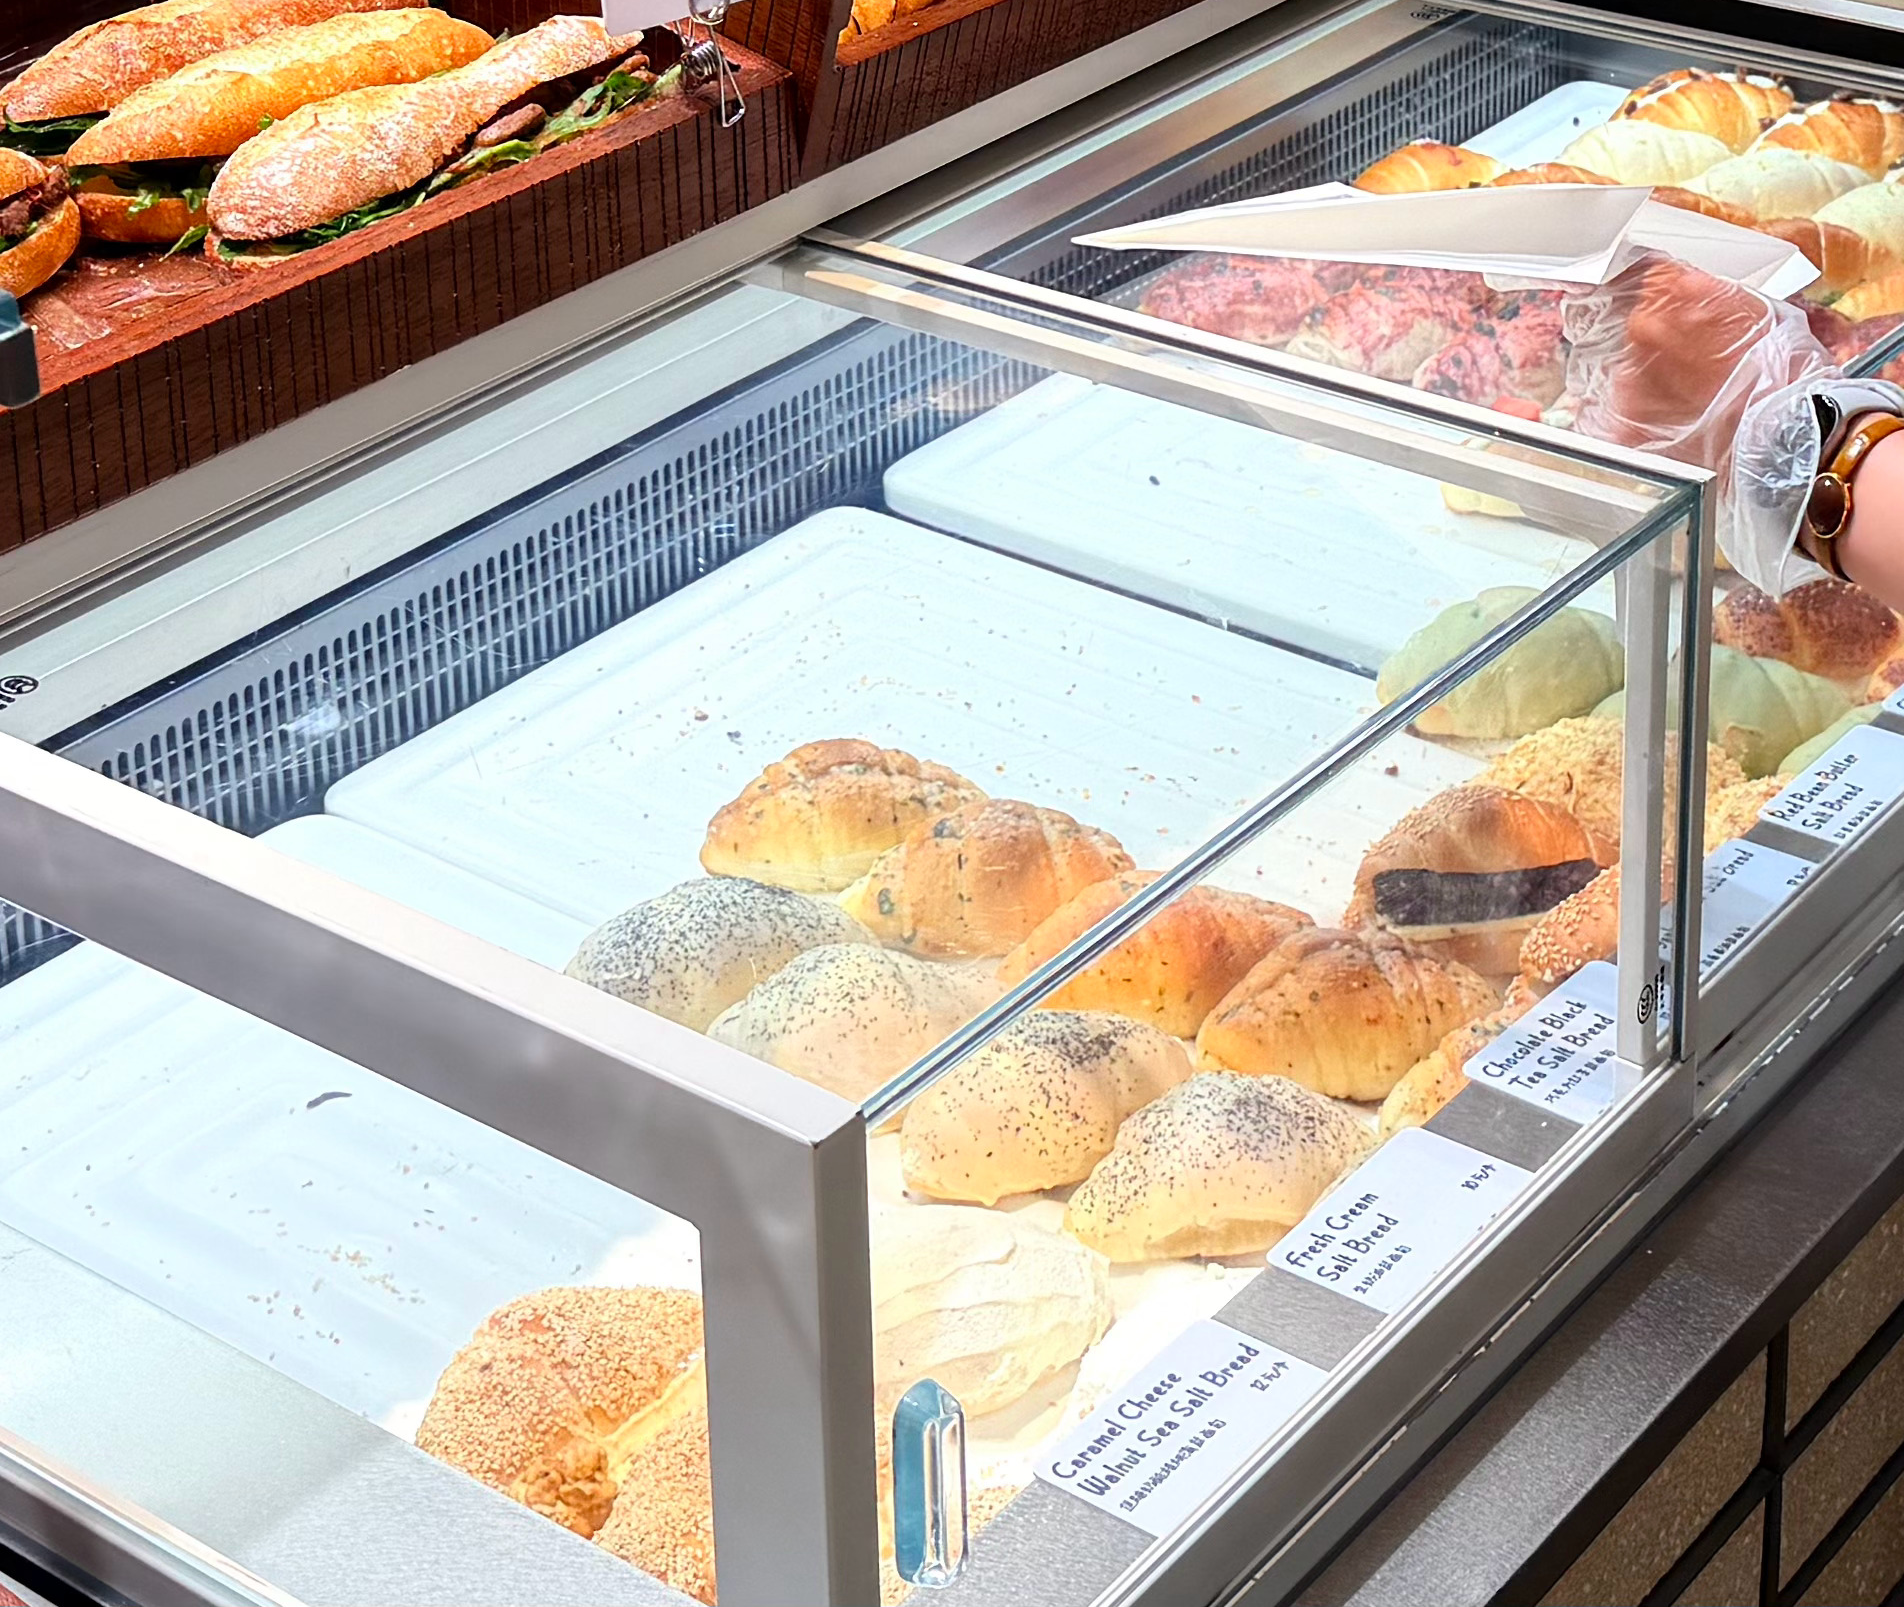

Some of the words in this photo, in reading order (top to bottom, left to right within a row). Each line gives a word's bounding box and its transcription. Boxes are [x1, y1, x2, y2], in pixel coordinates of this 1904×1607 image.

[1768, 799, 1805, 822] Red
[1789, 781, 1829, 804] Bean
[1814, 754, 1859, 782] Butter
[1802, 809, 1835, 831] Salt
[1818, 782, 1864, 812] Bread
[1482, 1029, 1554, 1079] Chocolate
[1539, 999, 1588, 1032] Black
[1507, 1070, 1547, 1090] Tea
[1537, 1045, 1576, 1070] Salt
[1561, 1012, 1616, 1049] Bread
[1284, 1231, 1337, 1269] Fresh
[1325, 1192, 1379, 1231] Cream
[1316, 1253, 1359, 1282] Salt
[1341, 1212, 1399, 1254] Bread
[1051, 1418, 1127, 1479] Caramel
[1117, 1371, 1182, 1420] Cheese
[1076, 1447, 1147, 1496] Walnut
[1137, 1419, 1181, 1447] Sea
[1169, 1386, 1214, 1418] Salt
[1198, 1341, 1260, 1388] Bread
